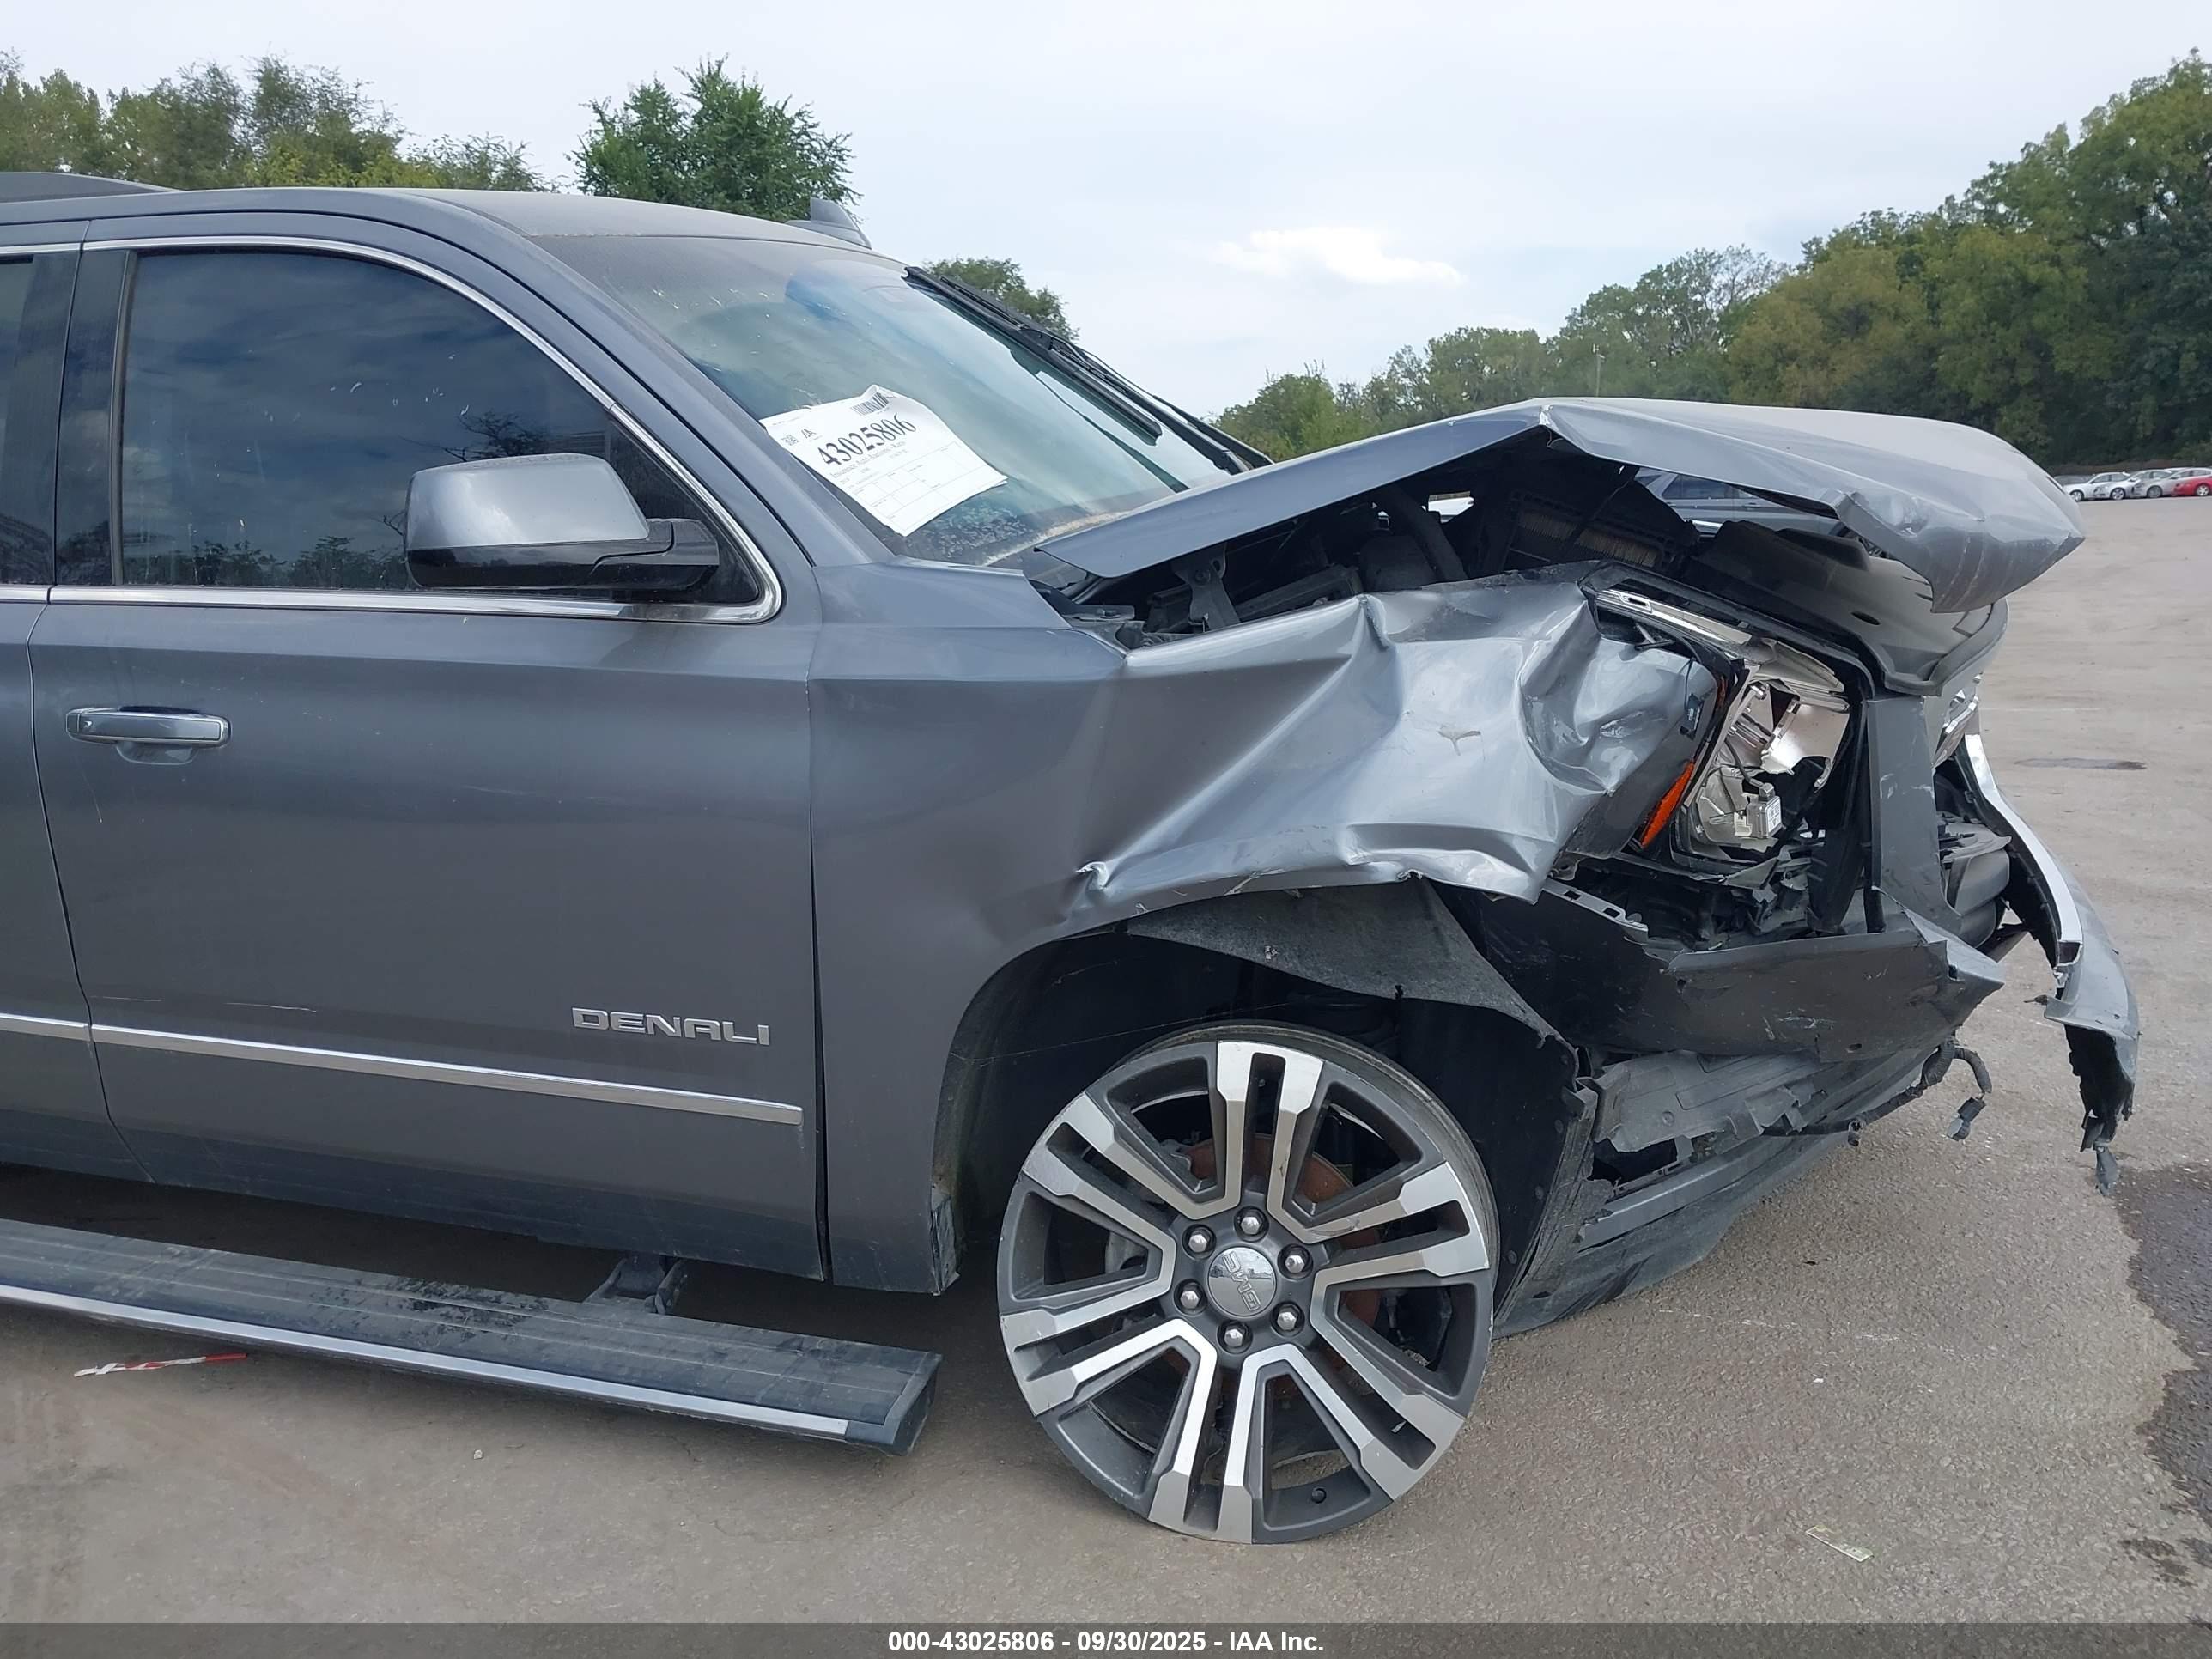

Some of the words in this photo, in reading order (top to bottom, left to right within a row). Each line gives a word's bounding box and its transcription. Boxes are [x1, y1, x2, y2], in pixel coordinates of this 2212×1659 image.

[817, 413, 916, 466] 43025806
[572, 1007, 770, 1046] DENALI
[1222, 1251, 1261, 1311] GMC
